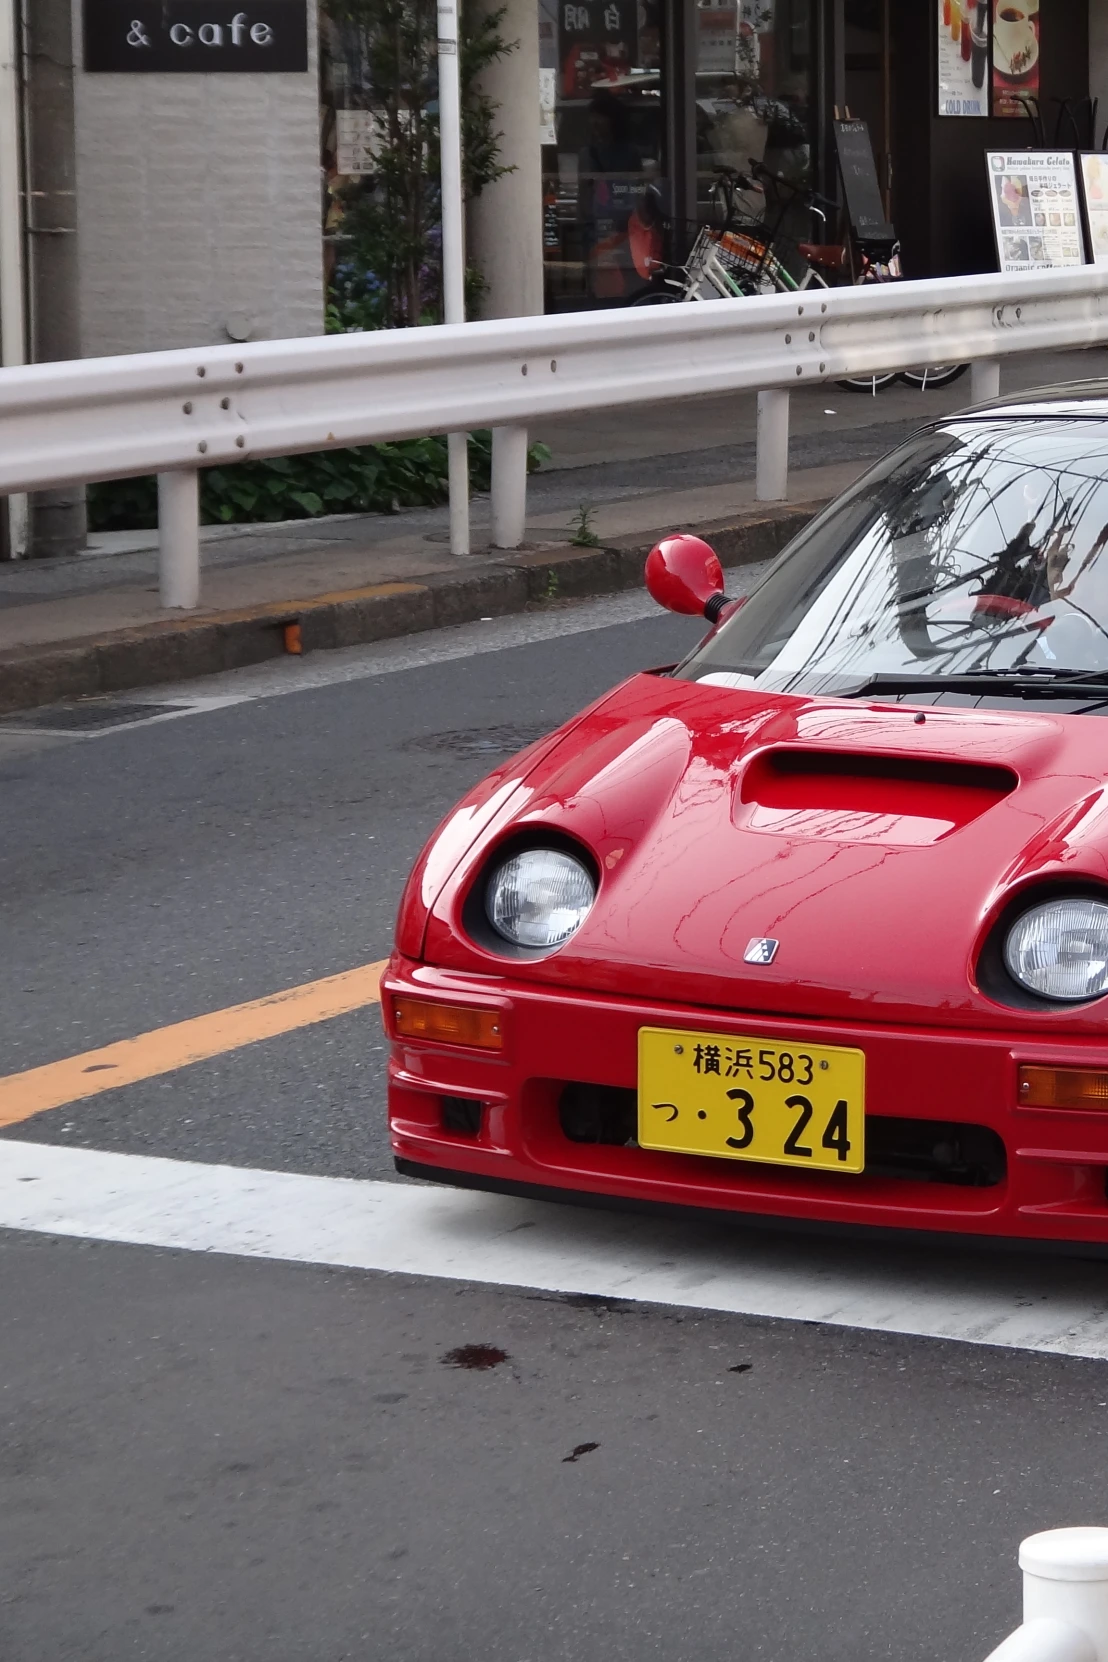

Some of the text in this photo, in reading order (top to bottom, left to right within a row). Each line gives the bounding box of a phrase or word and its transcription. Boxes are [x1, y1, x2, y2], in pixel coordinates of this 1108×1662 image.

[126, 12, 273, 47] & cafe
[946, 100, 960, 115] COLD
[1007, 156, 1070, 166] Kamakura Gelato
